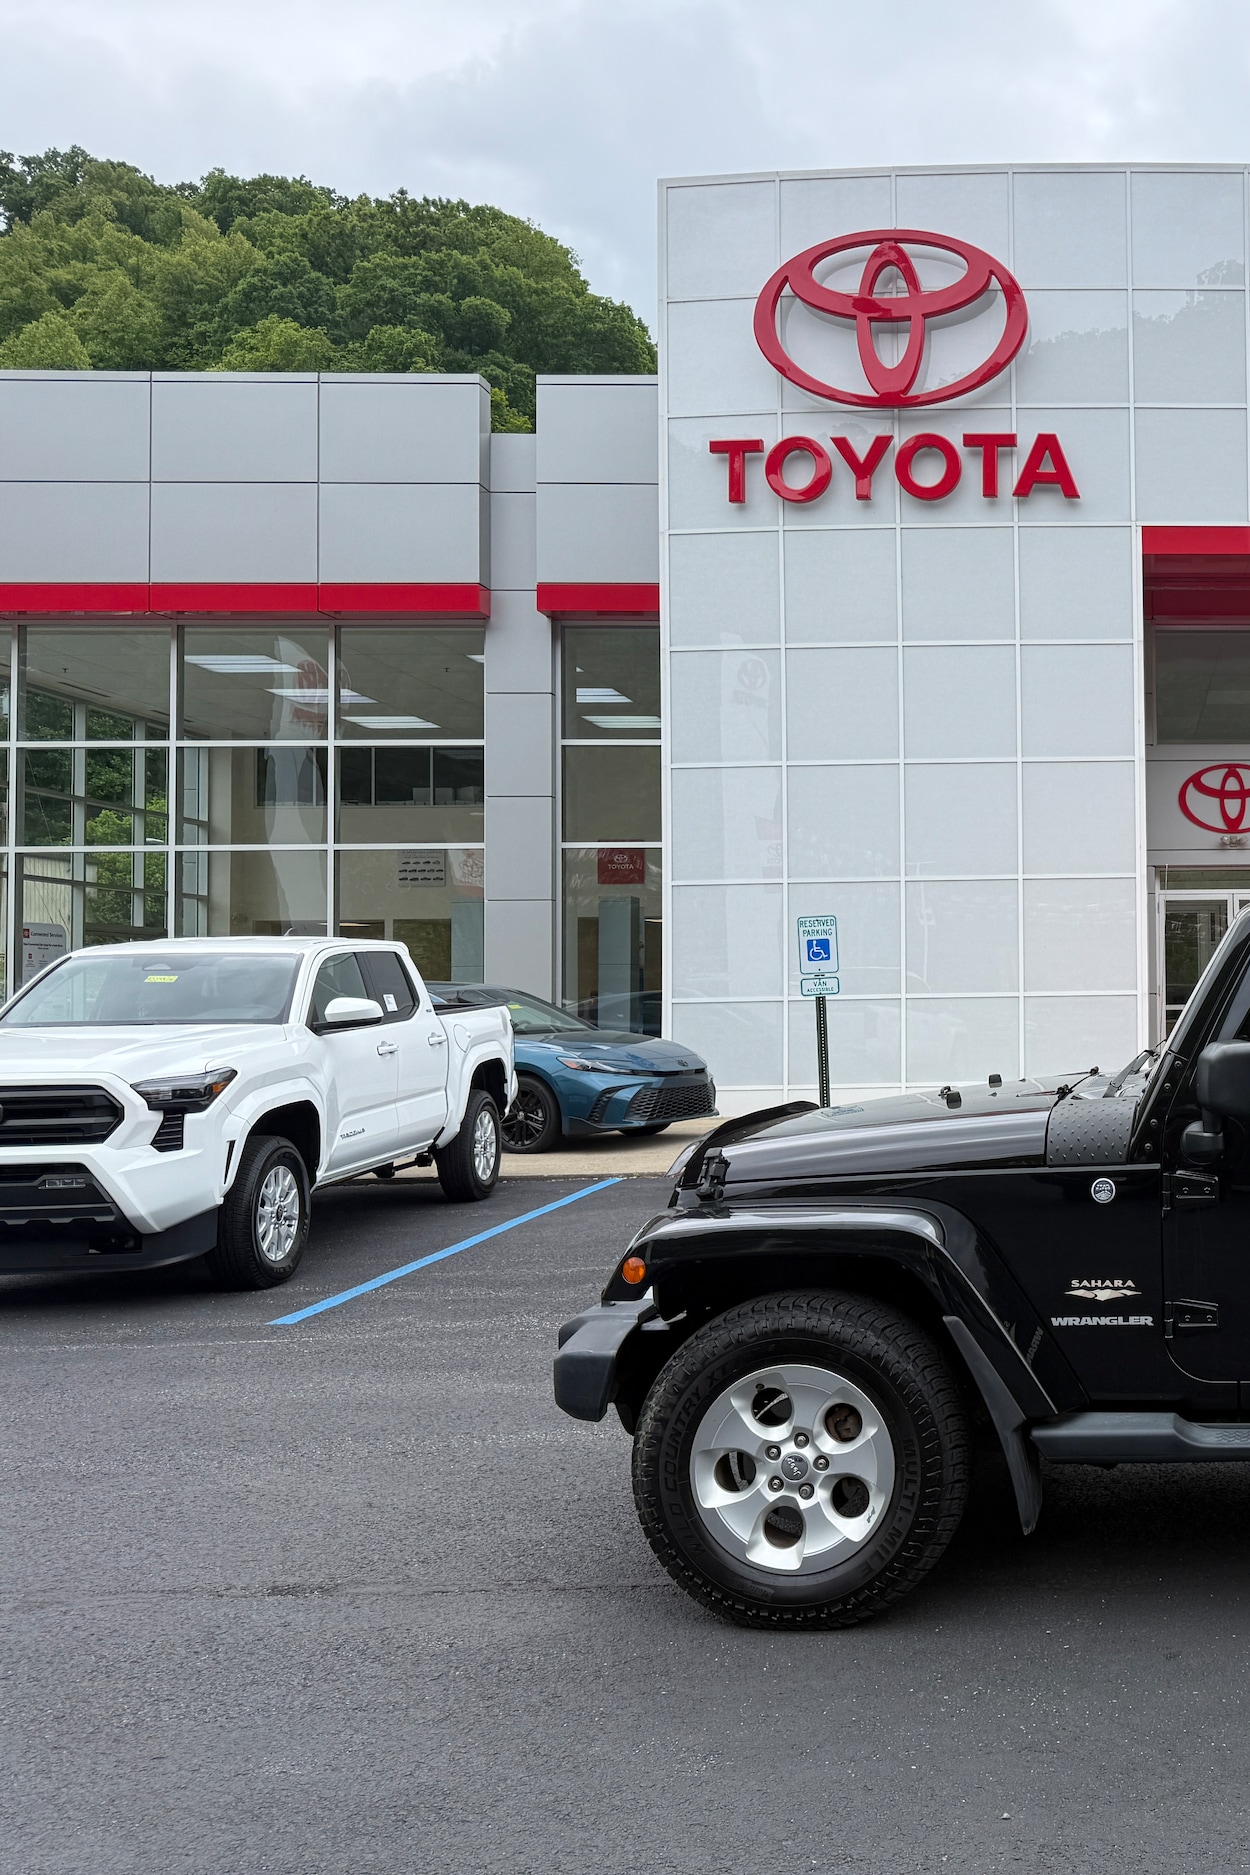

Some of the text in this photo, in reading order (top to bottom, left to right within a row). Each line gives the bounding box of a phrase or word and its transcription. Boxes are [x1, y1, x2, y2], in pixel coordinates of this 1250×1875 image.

[709, 432, 1081, 504] TOYOTA
[800, 919, 835, 928] RESERVED
[802, 928, 833, 937] PARKING
[1071, 1279, 1136, 1288] SAHARA
[1051, 1316, 1154, 1327] WRANGLER
[664, 1386, 702, 1492] COUNTRY
[857, 1438, 918, 1577] MULTI-MILE
